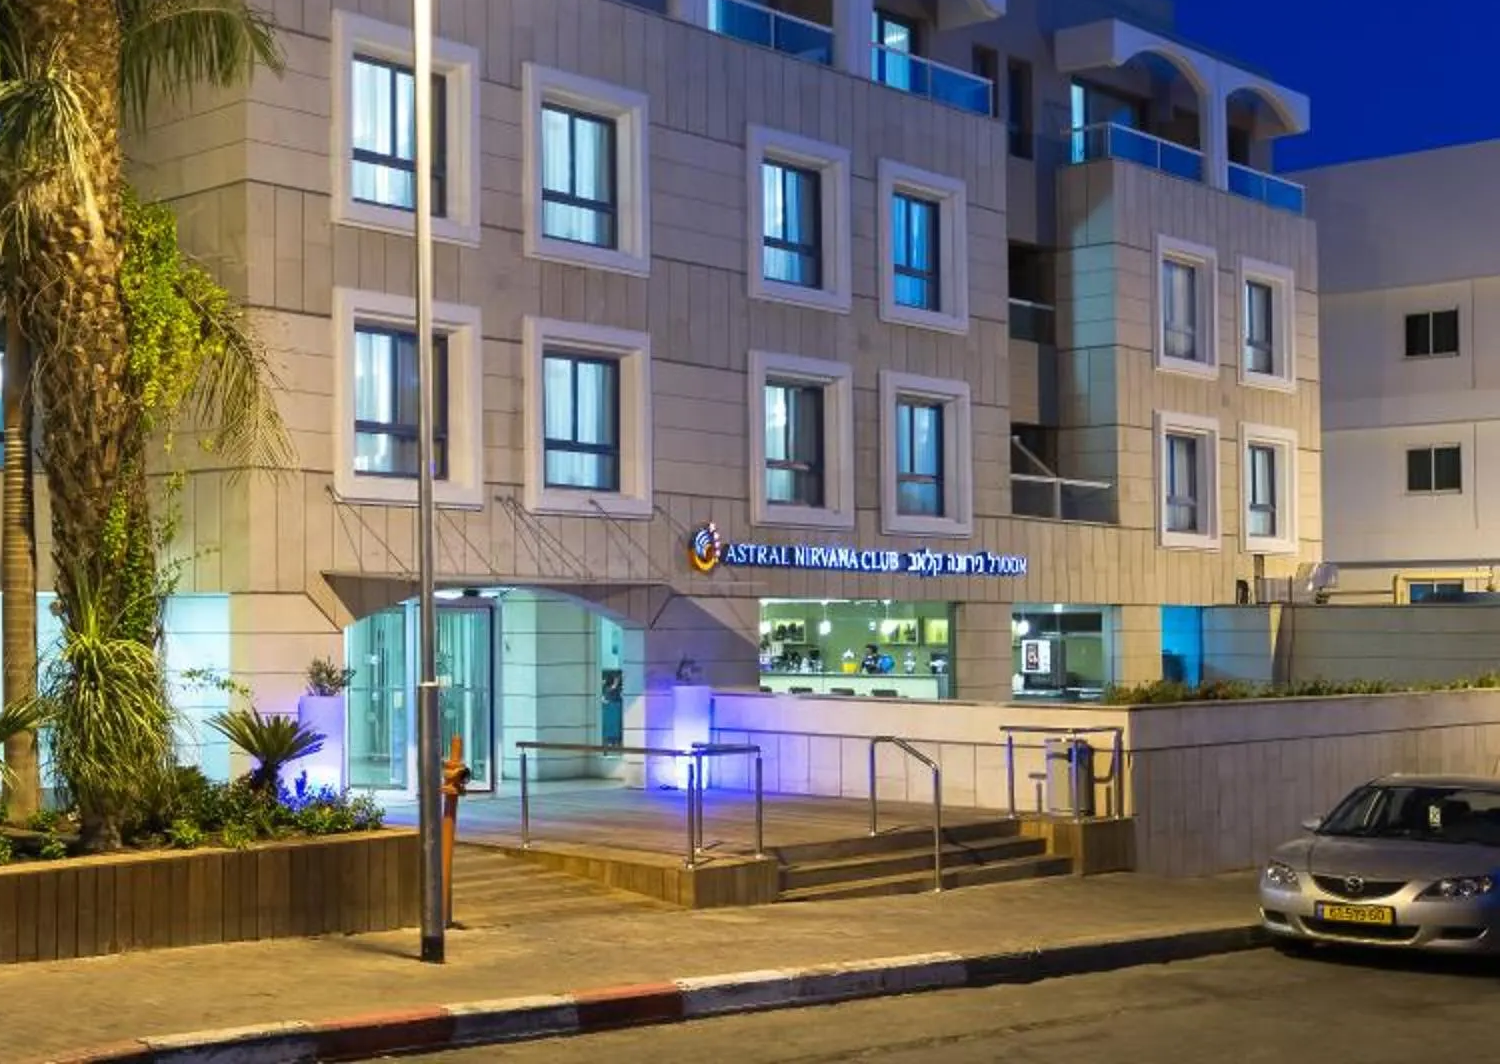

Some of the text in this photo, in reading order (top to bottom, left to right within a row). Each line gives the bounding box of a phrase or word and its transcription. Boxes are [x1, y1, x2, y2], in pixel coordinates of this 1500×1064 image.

[726, 543, 900, 571] ASTRAL NIRVANA CLUB
